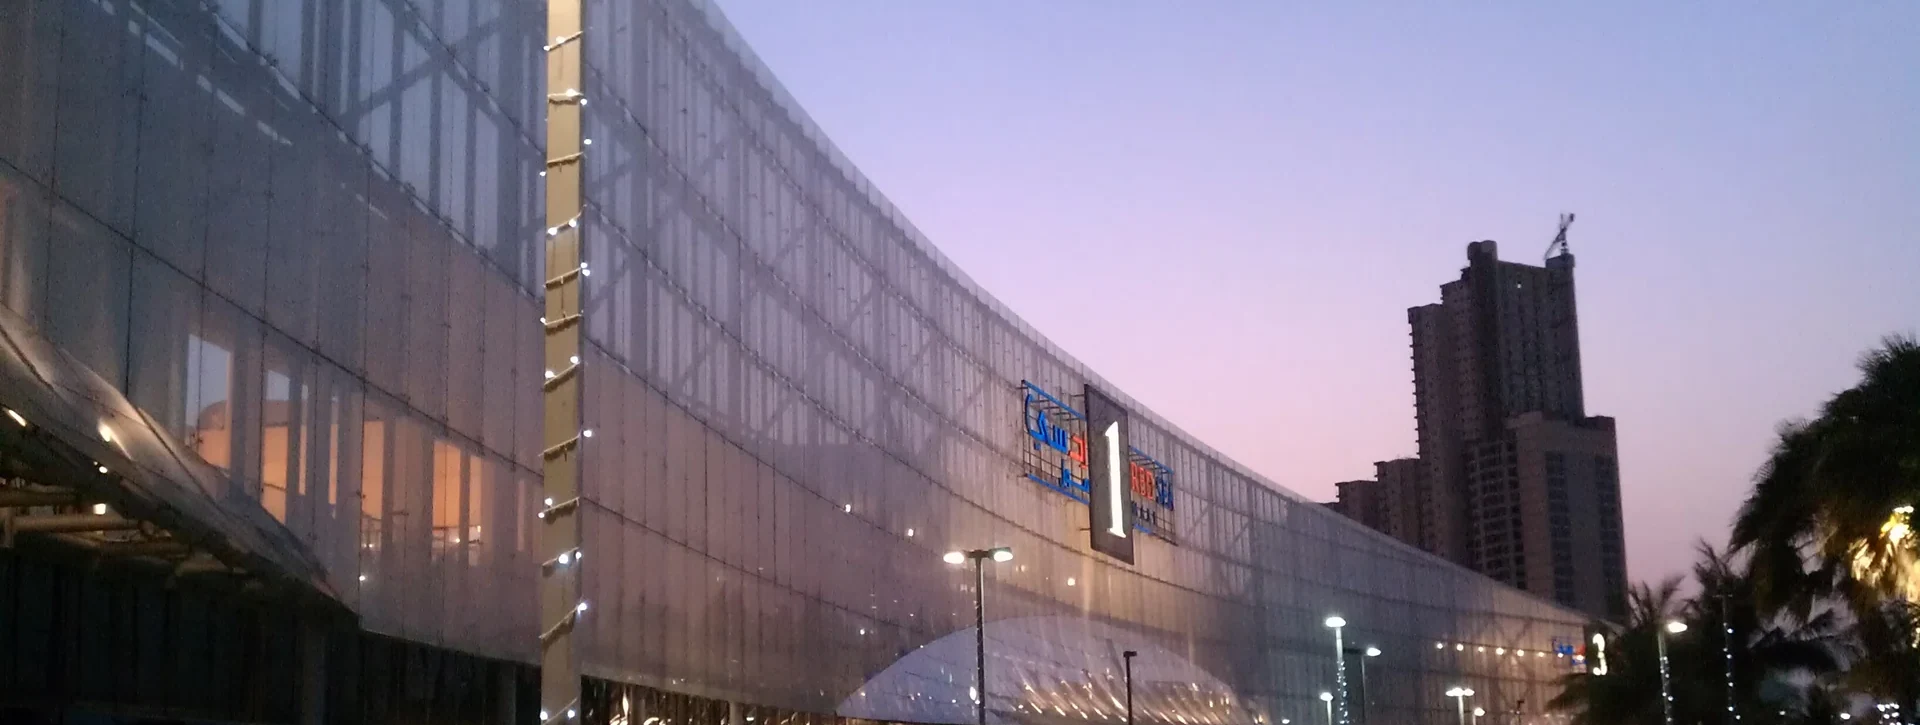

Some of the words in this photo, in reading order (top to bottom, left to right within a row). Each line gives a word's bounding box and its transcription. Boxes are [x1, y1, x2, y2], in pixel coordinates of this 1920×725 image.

[1104, 421, 1127, 538] 1
[1130, 462, 1154, 500] RED
[1155, 476, 1174, 511] SEA
